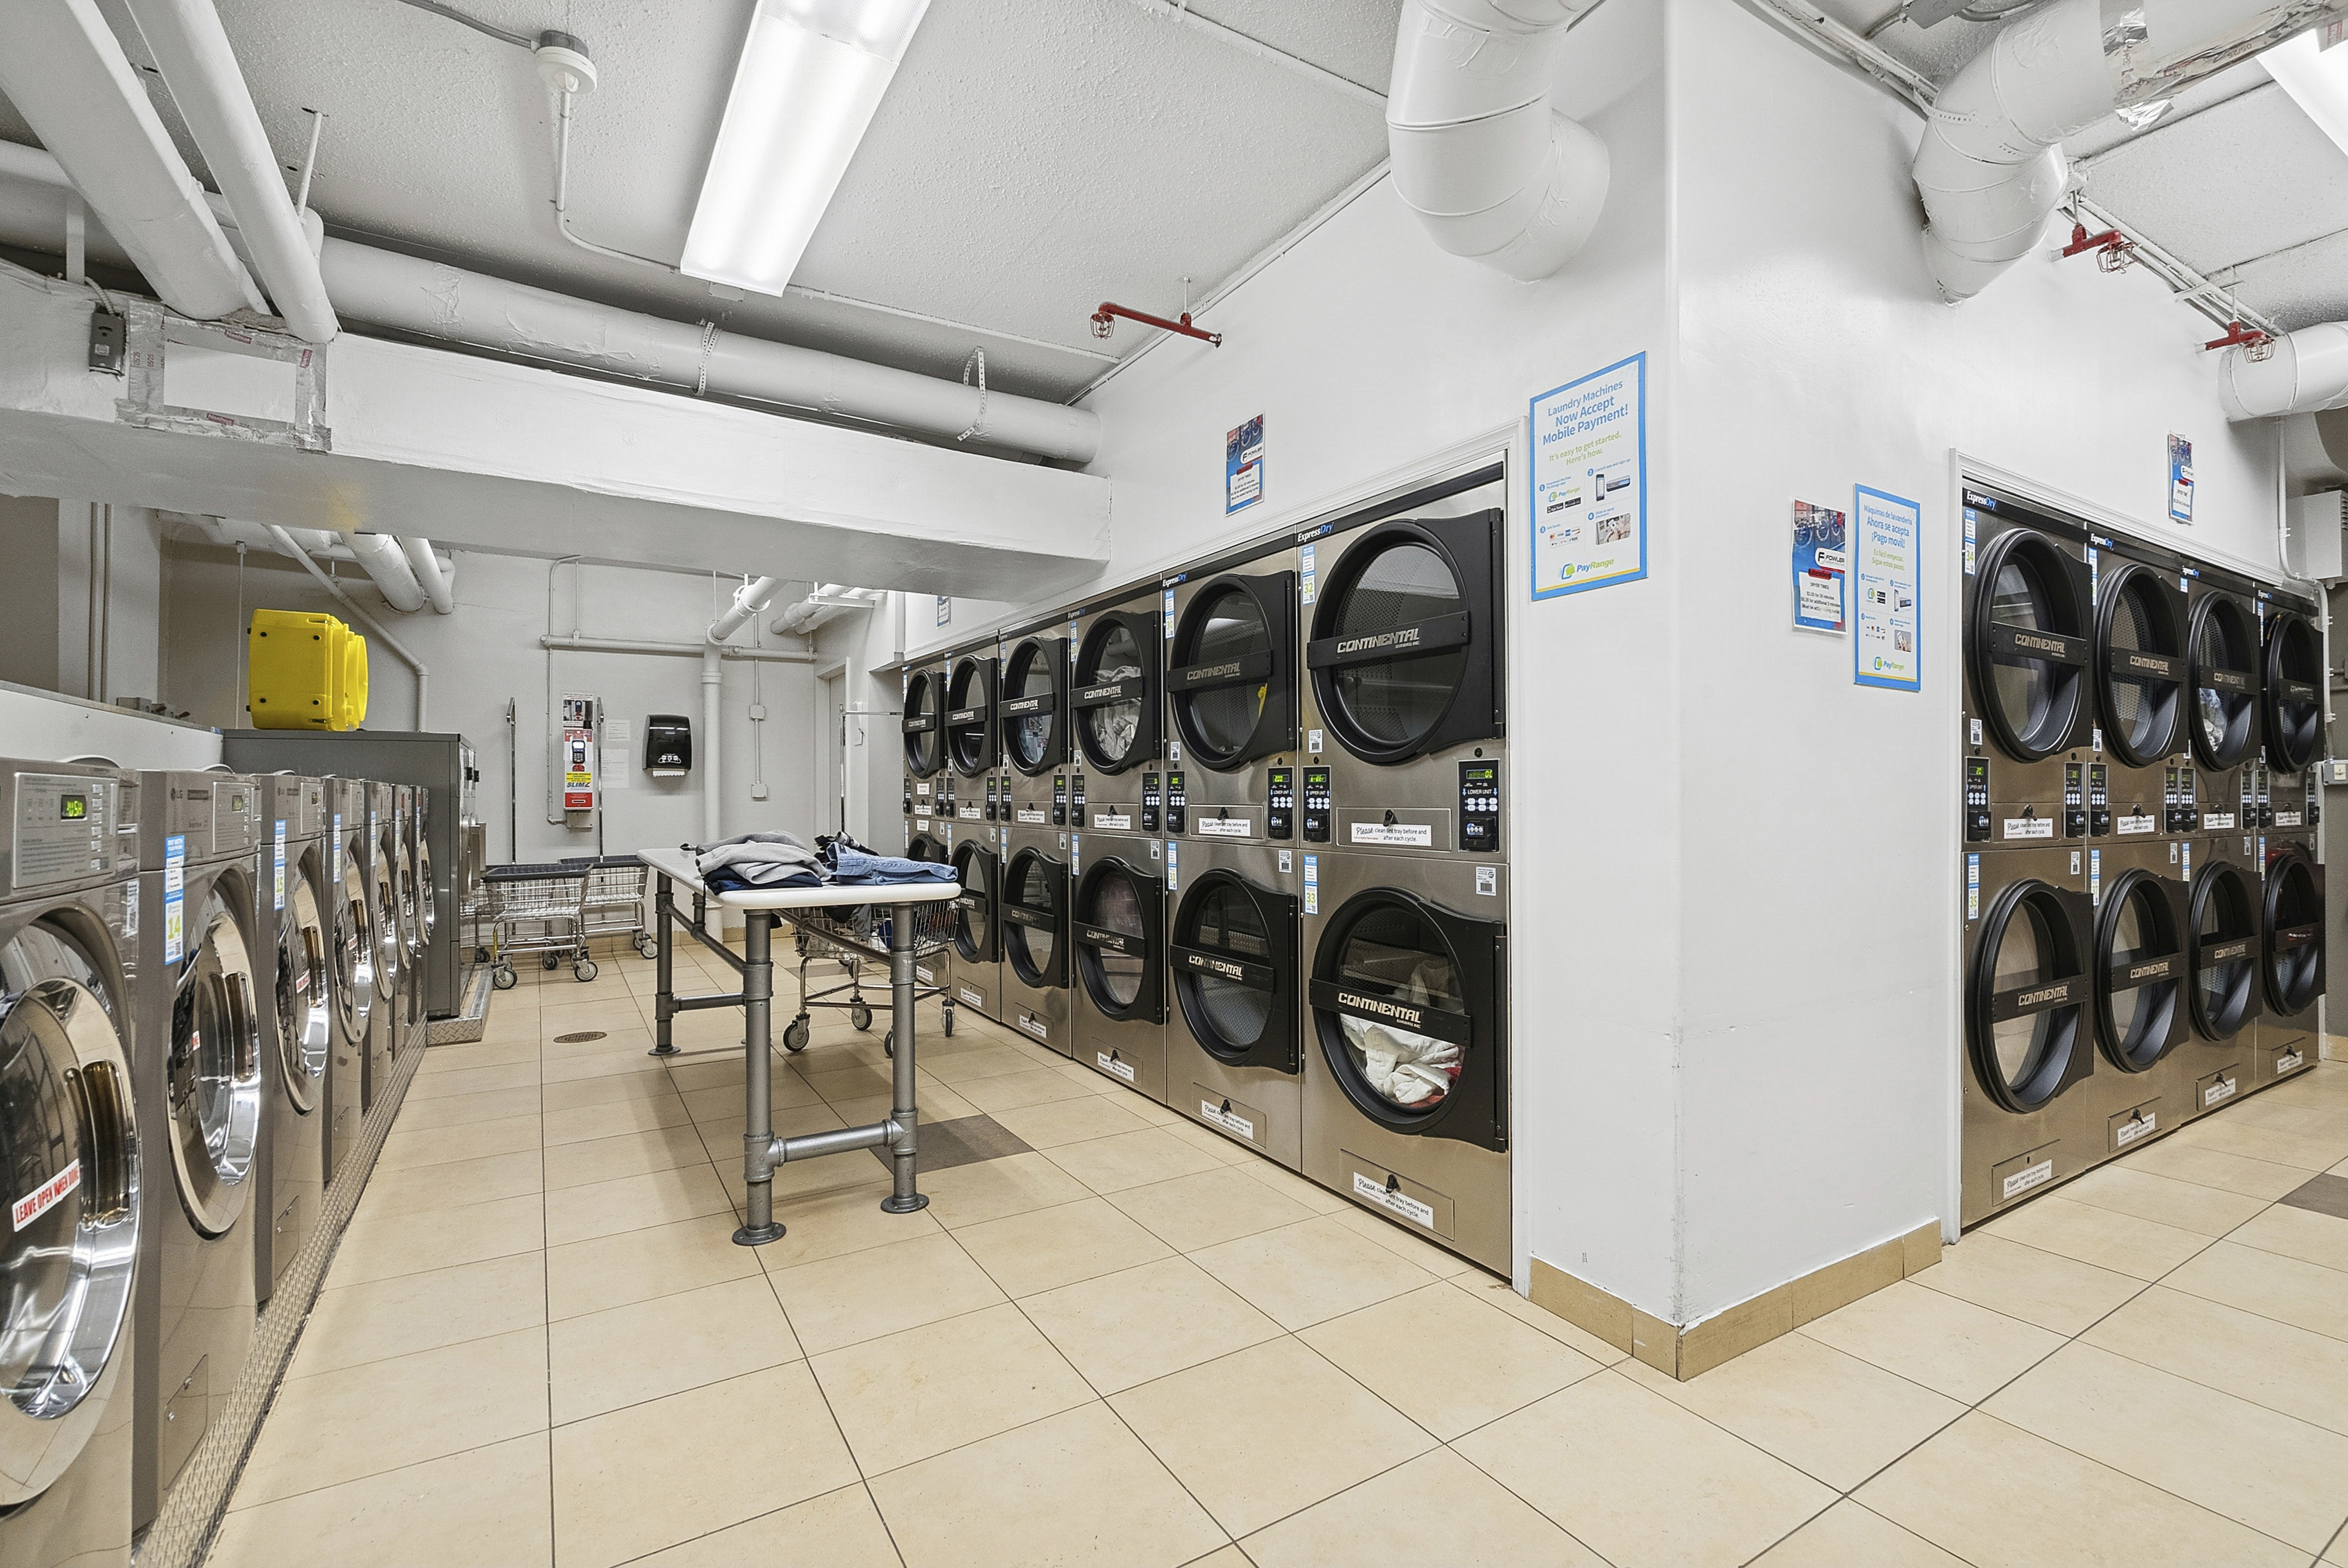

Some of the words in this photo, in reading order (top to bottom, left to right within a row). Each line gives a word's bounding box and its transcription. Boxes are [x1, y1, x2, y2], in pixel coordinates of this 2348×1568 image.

[2228, 43, 2252, 58] 05/25
[226, 331, 251, 343] Nashua
[1548, 398, 1581, 416] Laundry
[1583, 381, 1623, 403] Machines
[207, 413, 233, 425] Nashua
[1556, 411, 1578, 427] Now
[1580, 396, 1614, 418] Accept
[1543, 426, 1575, 445] Mobile
[1578, 404, 1628, 433] Payment!
[1560, 448, 1574, 458] easy
[1584, 441, 1594, 451] get
[1595, 431, 1622, 446] started.
[1566, 453, 1586, 465] Here's
[1587, 448, 1603, 458] how.
[1966, 491, 1996, 510] ExpressDry
[1298, 523, 1333, 542] ExpressDry
[1867, 516, 1884, 529] Ahora
[1885, 523, 1891, 532] se
[1892, 525, 1910, 537] acepta
[1966, 550, 1974, 562] 34
[1577, 559, 1614, 572] PayRange
[1163, 574, 1186, 587] ExpressDry
[1304, 582, 1313, 593] 32
[1167, 620, 1173, 630] 30
[1337, 628, 1419, 653] CONTINENTAL
[2015, 634, 2065, 653] CONTINENTAL
[1187, 662, 1240, 680] CONTINENTAL
[1883, 660, 1904, 671] PayRange
[2130, 655, 2169, 671] CONTINENTAL
[1084, 685, 1122, 699] CONTINENTAL
[1010, 700, 1038, 710] CONTINENTAL
[952, 711, 974, 720] CONTINENTAL
[1306, 892, 1316, 904] 33
[1969, 896, 1977, 908] 35
[168, 915, 181, 939] 14
[2215, 944, 2246, 959] CONTINENTAL
[1189, 955, 1243, 977] CONTINENTAL
[2130, 961, 2169, 979] CONTINENTAL
[2019, 985, 2068, 1006] CONTINENTAL
[1338, 993, 1421, 1023] CONTINENTAL
[15, 1197, 36, 1224] LEAVE
[37, 1185, 53, 1209] OPEN
[53, 1174, 69, 1197] WHEN
[1359, 1178, 1376, 1191] Please
[1405, 1199, 1419, 1211] before
[1385, 1198, 1395, 1207] after
[1396, 1204, 1406, 1213] each
[1407, 1210, 1419, 1219] cycle.
